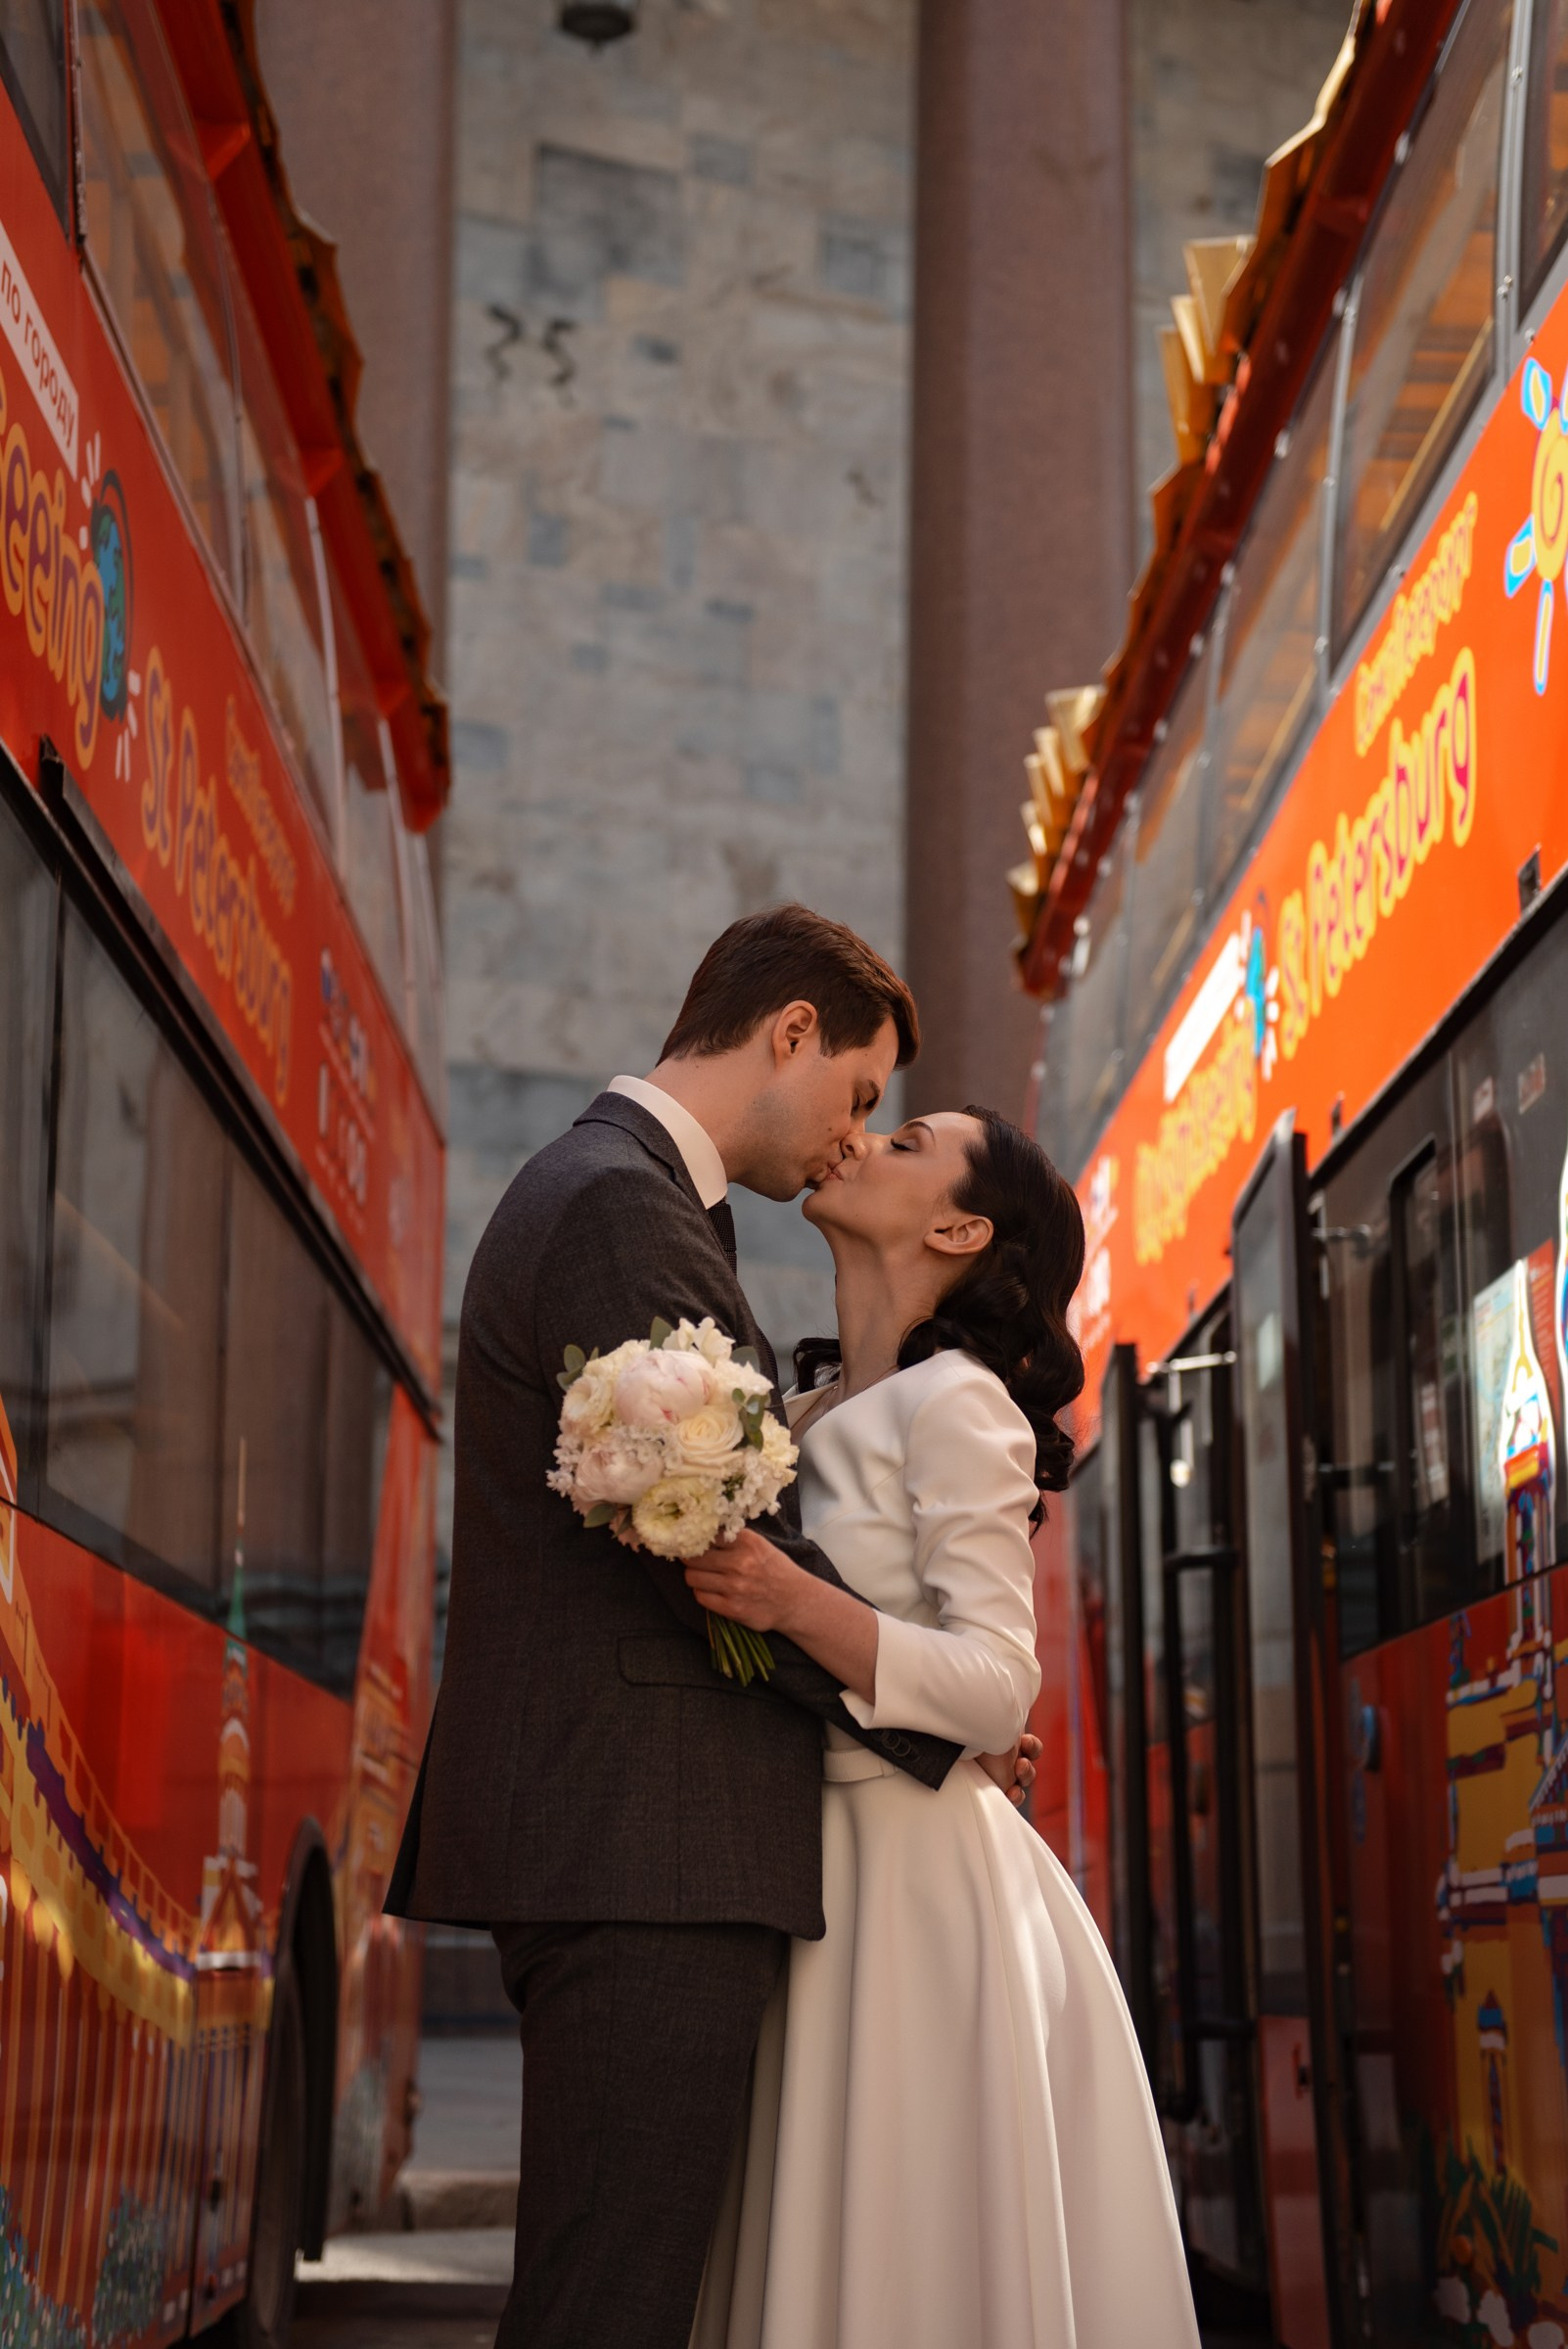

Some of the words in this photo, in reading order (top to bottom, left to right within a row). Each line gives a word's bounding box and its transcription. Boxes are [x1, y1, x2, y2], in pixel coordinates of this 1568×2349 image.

[2, 259, 21, 324] по
[24, 311, 74, 448] городу
[0, 365, 104, 770] eeing
[142, 644, 174, 869] St
[175, 704, 290, 1109] Petersburg
[1277, 889, 1310, 1061] St
[1307, 647, 1476, 1018] Petersburg
